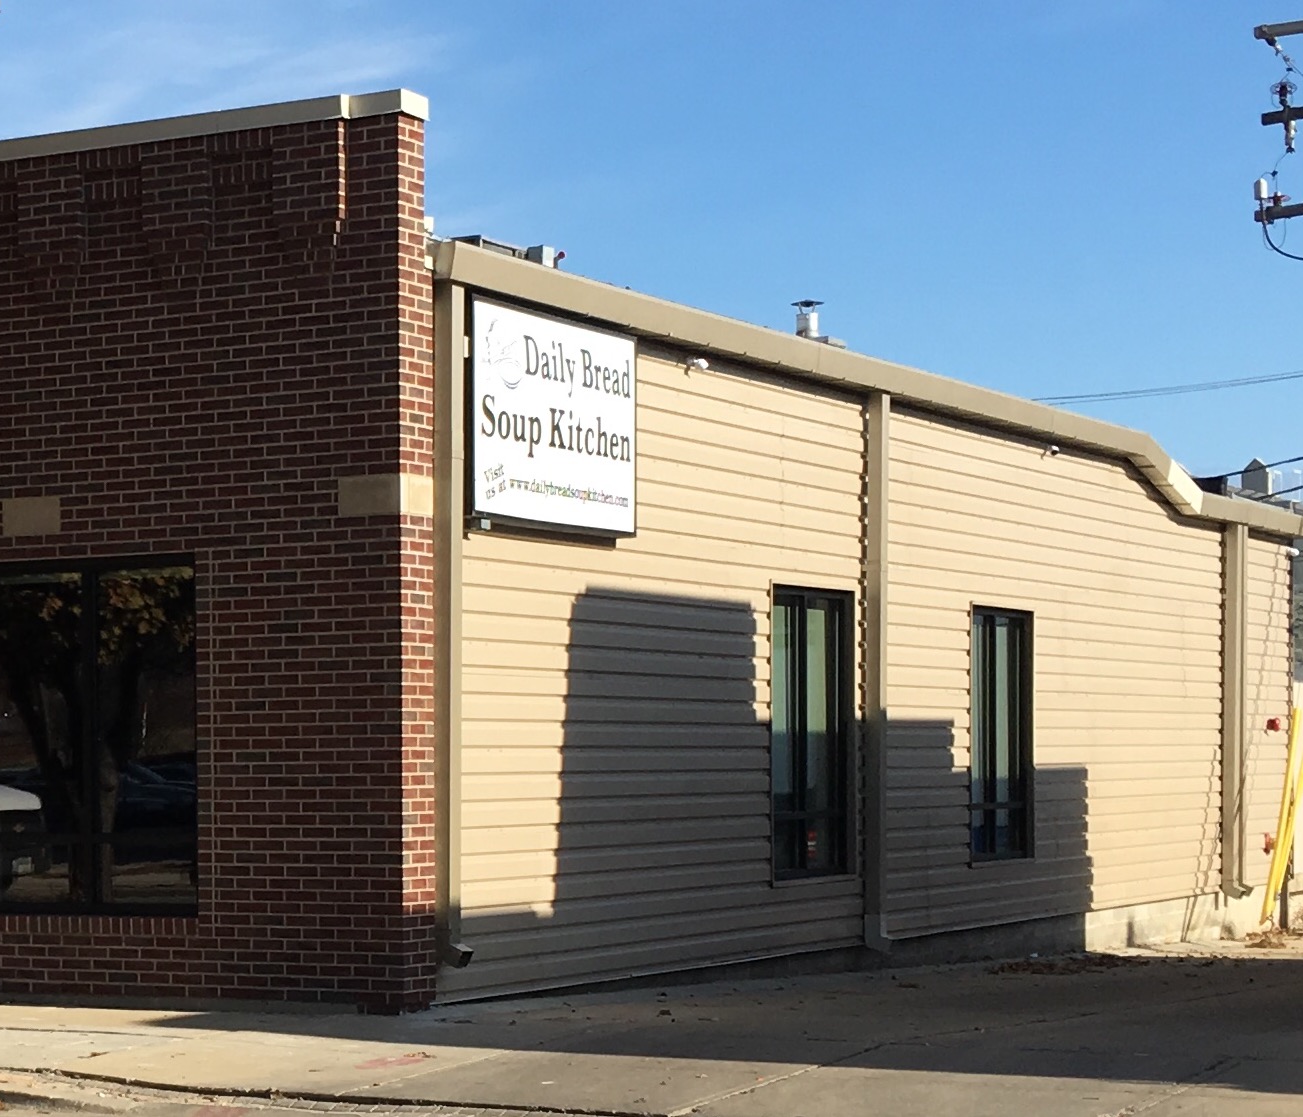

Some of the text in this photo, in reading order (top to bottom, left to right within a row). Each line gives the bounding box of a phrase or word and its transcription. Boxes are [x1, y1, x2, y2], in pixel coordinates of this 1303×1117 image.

[523, 335, 631, 398] Daily Bread
[481, 394, 631, 462] Soup Kitchen
[484, 464, 505, 482] Visit
[485, 478, 629, 507] us at www.dailybreadsoupkitchen.com
